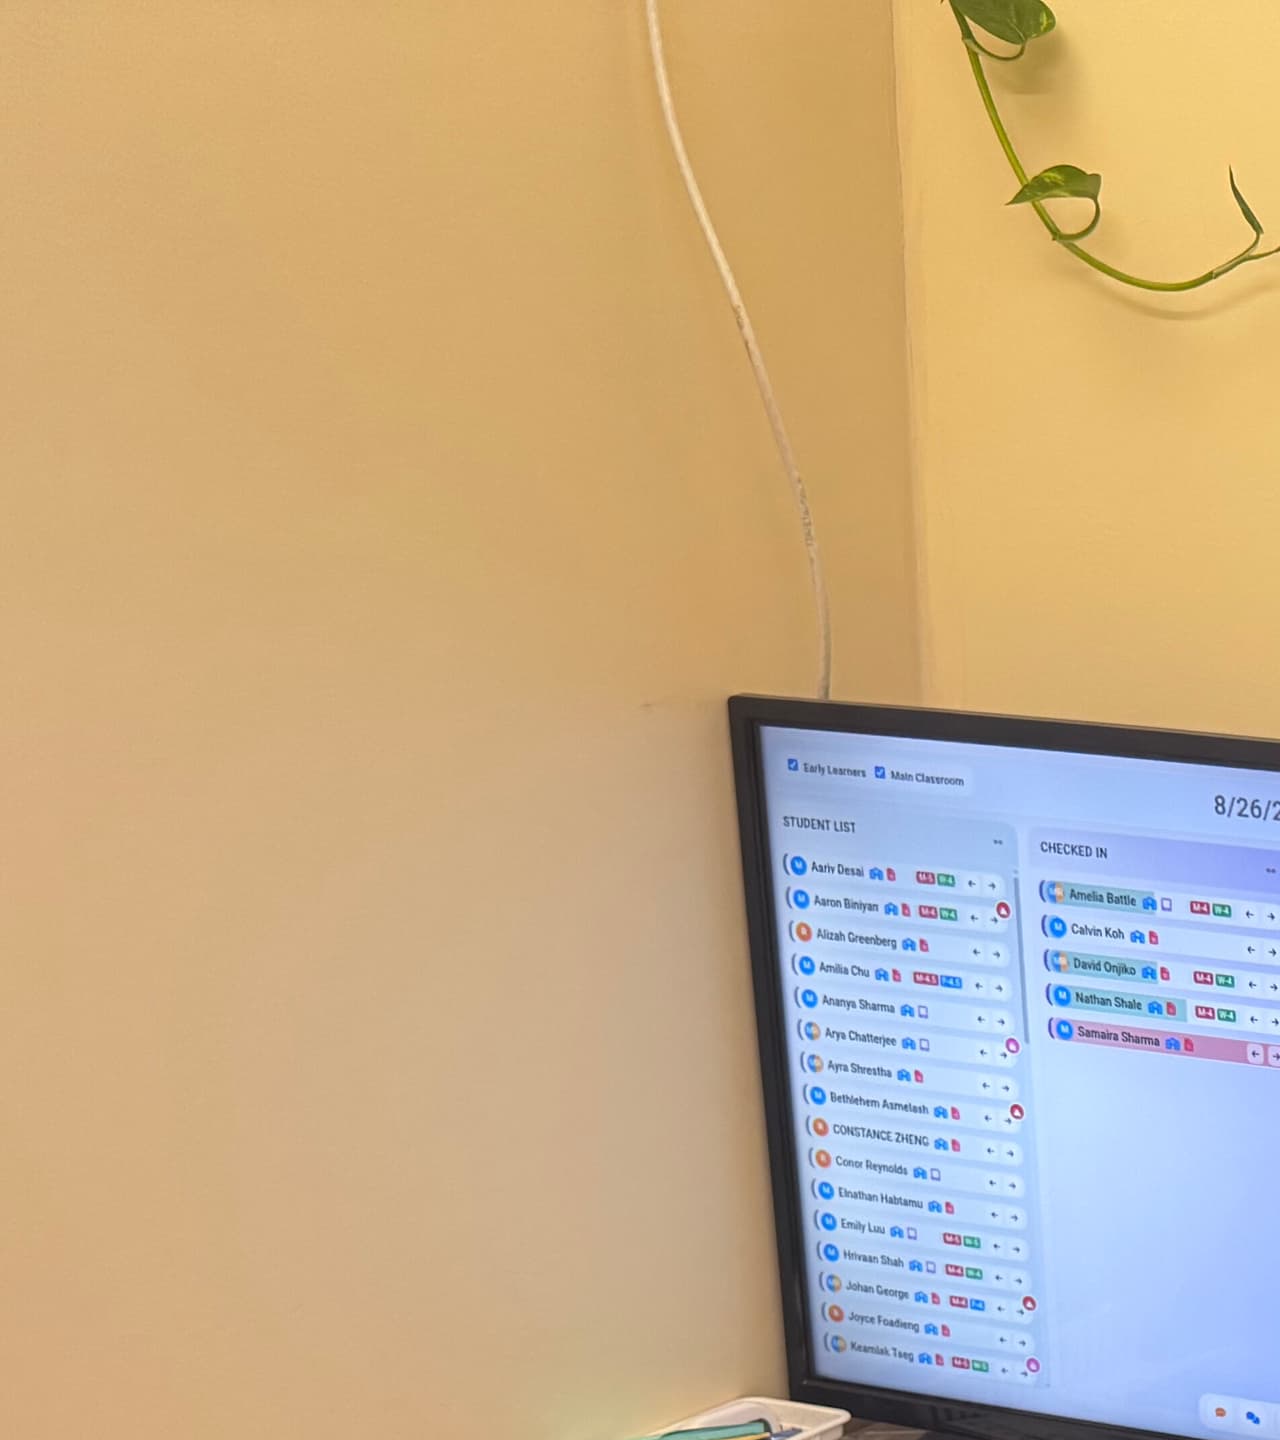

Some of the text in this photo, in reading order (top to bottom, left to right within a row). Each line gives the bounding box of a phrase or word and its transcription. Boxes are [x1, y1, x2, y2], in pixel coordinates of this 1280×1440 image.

[803, 763, 867, 778] Early Learners
[891, 770, 965, 786] Main Classroom
[783, 816, 856, 833] STUDENT LIST
[1040, 841, 1108, 860] CHECKED IN
[837, 864, 865, 877] Desai
[814, 895, 842, 909] Aaron
[843, 898, 879, 914] Biniyan
[1070, 889, 1104, 903] Amelia
[1106, 892, 1136, 906] Battle
[817, 928, 897, 950] Alizah Greenberg
[1071, 923, 1102, 937] Calvin
[1104, 927, 1125, 940] Koh
[819, 962, 849, 975] Amilia
[851, 965, 870, 978] Chu
[1073, 957, 1101, 971] David
[1103, 961, 1136, 976] Onjiko
[822, 995, 857, 1011] Ananya
[859, 999, 896, 1014] Sharma
[1075, 992, 1112, 1007] Nathan
[1114, 997, 1142, 1010] Shale
[825, 1027, 897, 1048] Arya Chatterjee
[1078, 1026, 1119, 1041] Samaira
[1121, 1032, 1160, 1047] Sharma
[828, 1060, 892, 1078] Ayra Shrestha
[830, 1091, 880, 1108] Bethlehem
[833, 1124, 929, 1147] CONSTANCE ZHENG
[835, 1156, 908, 1175] Conor Reynolds
[838, 1187, 923, 1209] Elnathan Habtamu
[841, 1218, 865, 1234] Emily
[880, 1255, 904, 1268] Shah
[846, 1281, 874, 1293] Johan
[876, 1285, 910, 1300] George
[848, 1312, 876, 1325] Joyce
